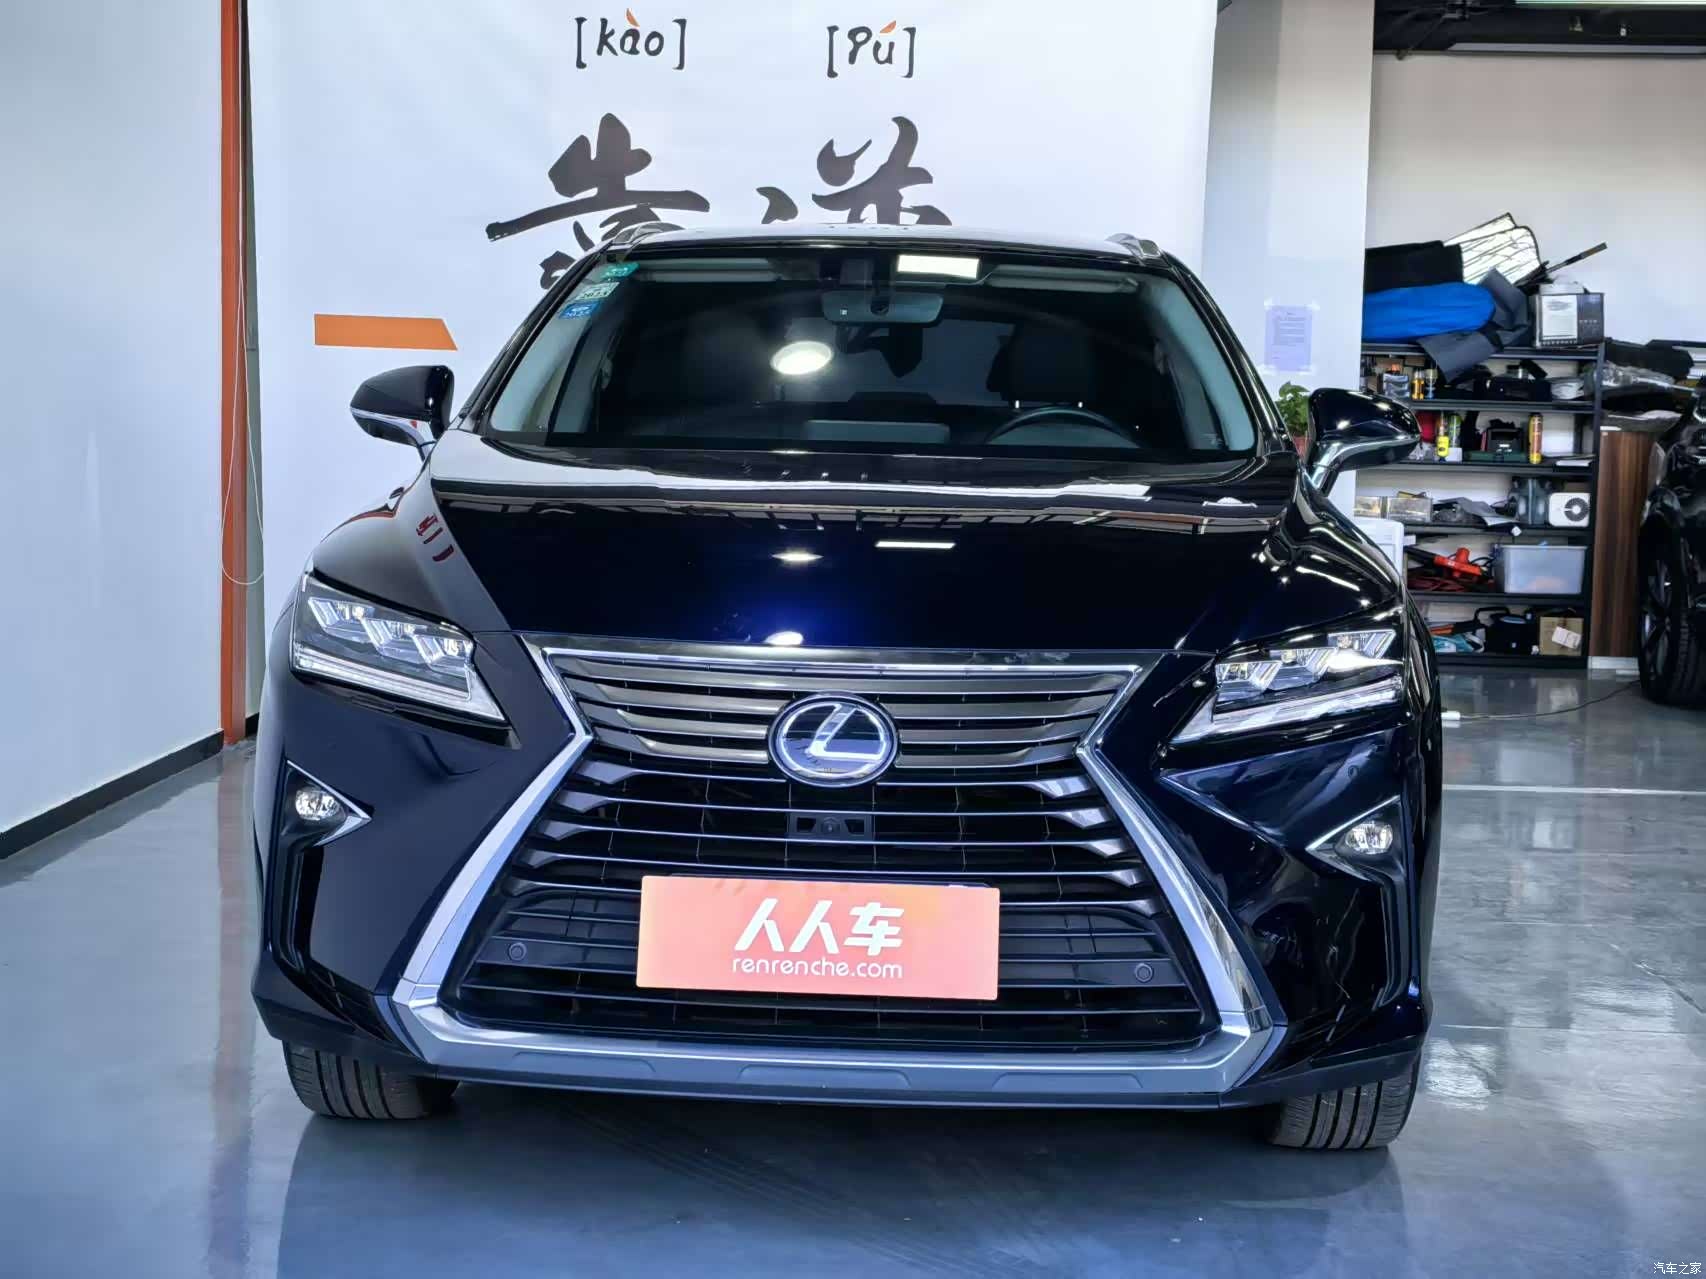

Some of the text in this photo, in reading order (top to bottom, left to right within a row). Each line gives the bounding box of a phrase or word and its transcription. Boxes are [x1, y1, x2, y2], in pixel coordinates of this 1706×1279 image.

[734, 897, 905, 956] 人人车
[732, 956, 904, 979] renrenche.com
